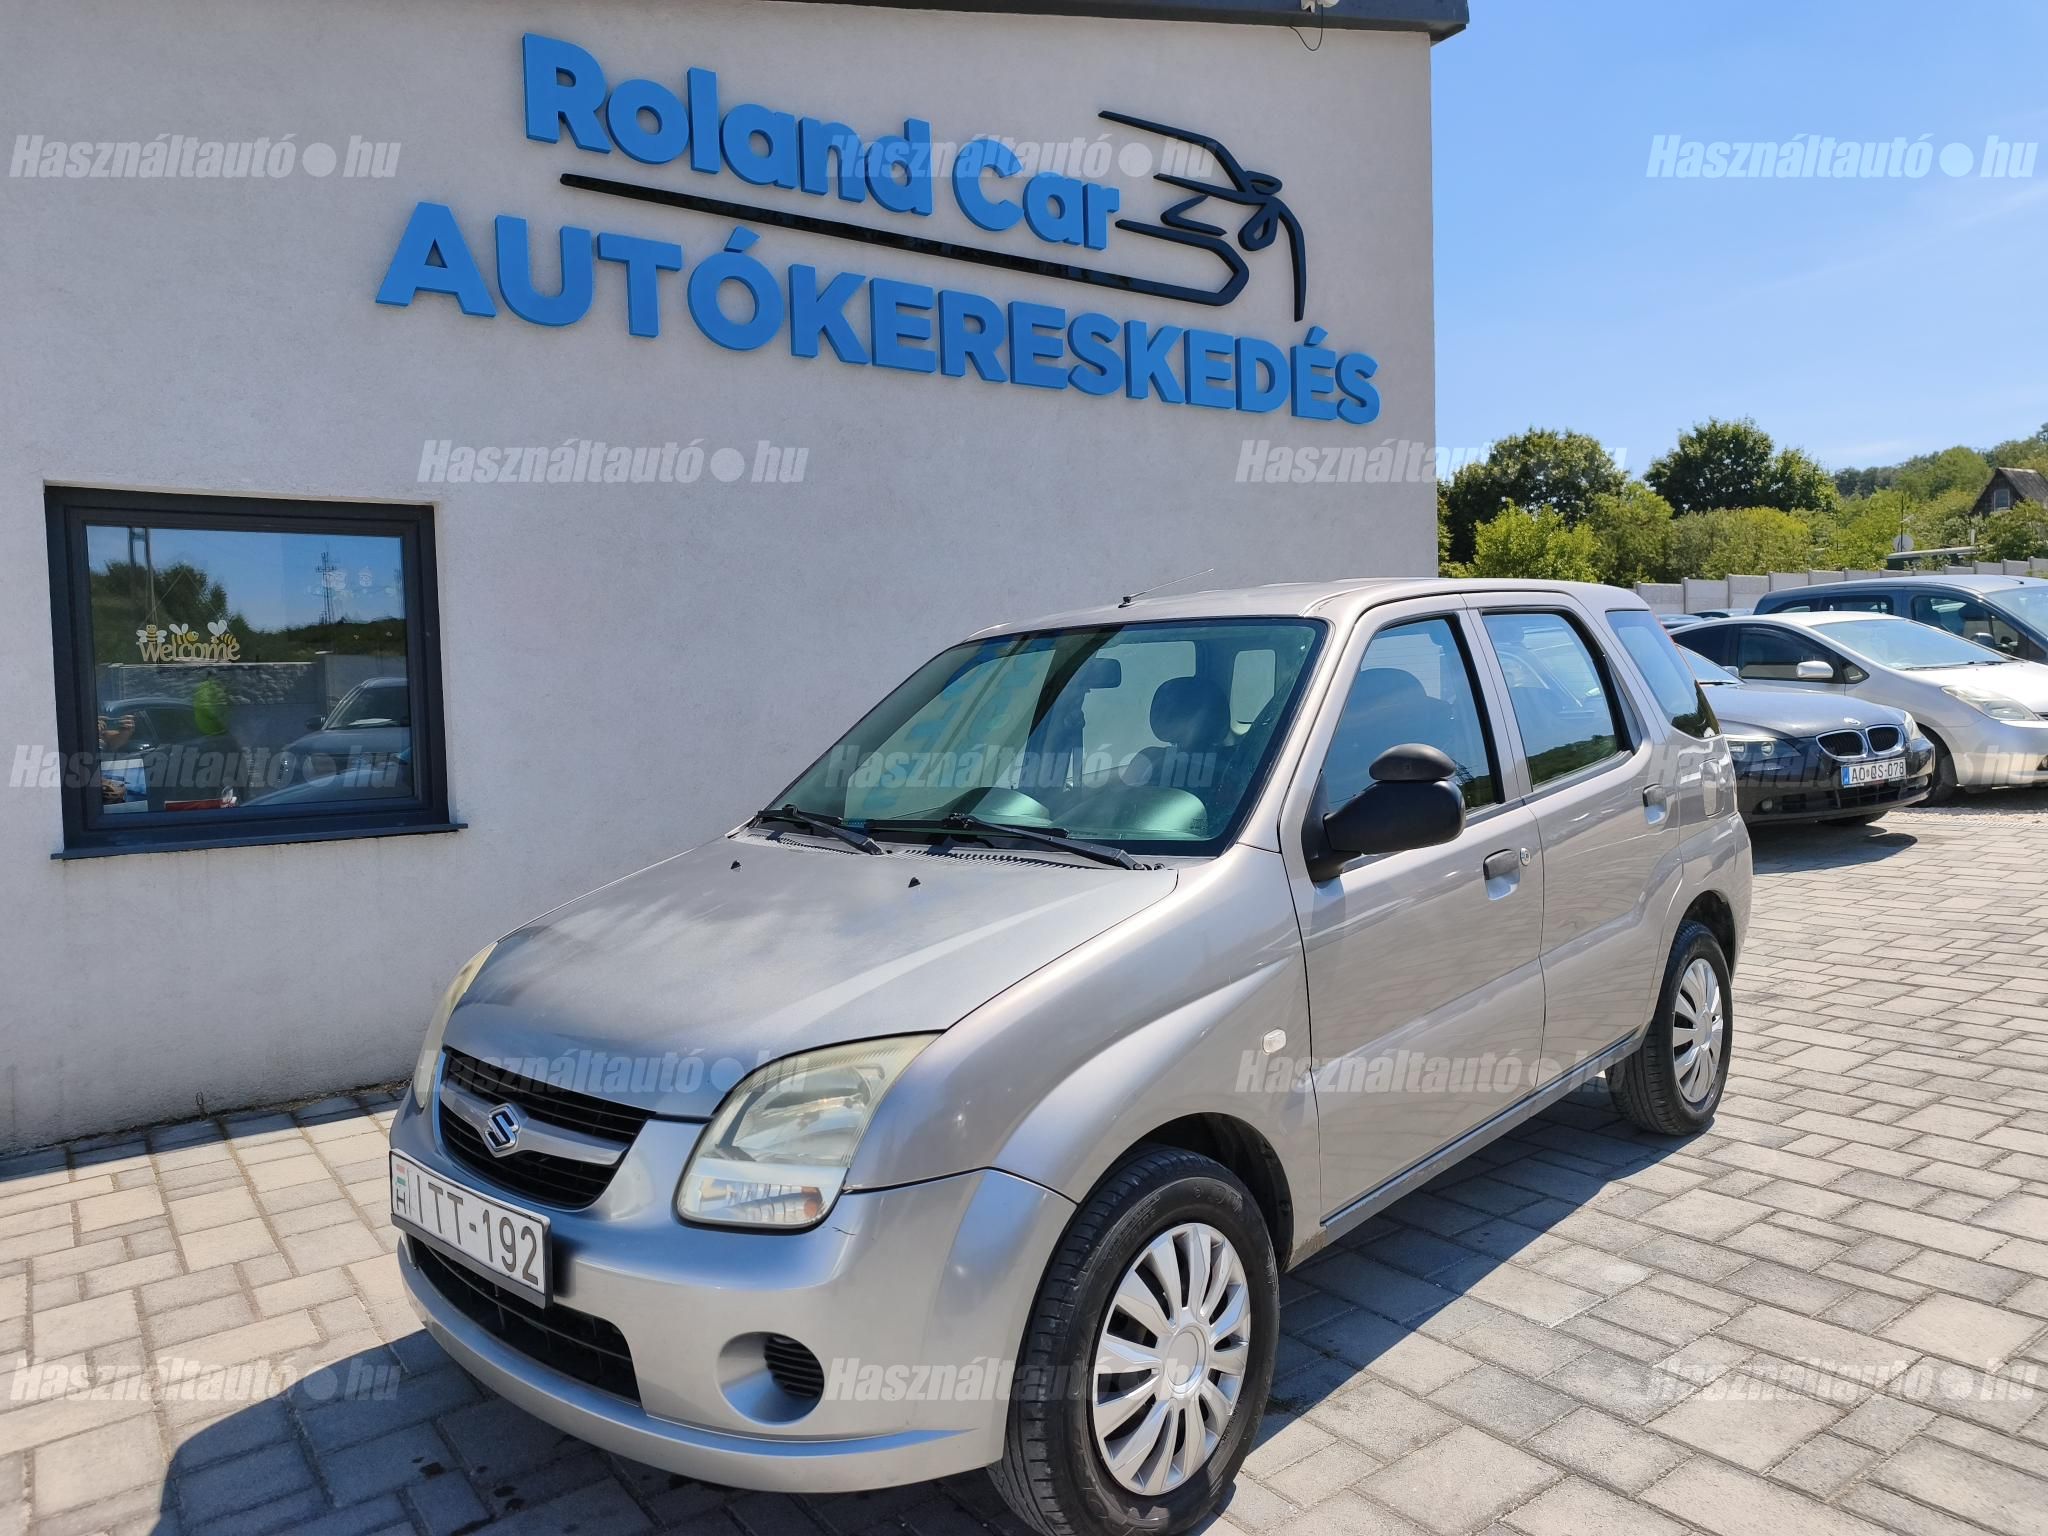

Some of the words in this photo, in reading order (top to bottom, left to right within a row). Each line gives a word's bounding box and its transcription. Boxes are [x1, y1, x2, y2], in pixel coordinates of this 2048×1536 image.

[522, 33, 933, 216] Roland
[952, 138, 1120, 250] Car
[375, 202, 1381, 425] AUTÓKERESKEDÉS
[136, 633, 240, 662] Welcome
[416, 1174, 539, 1286] ITT-192
